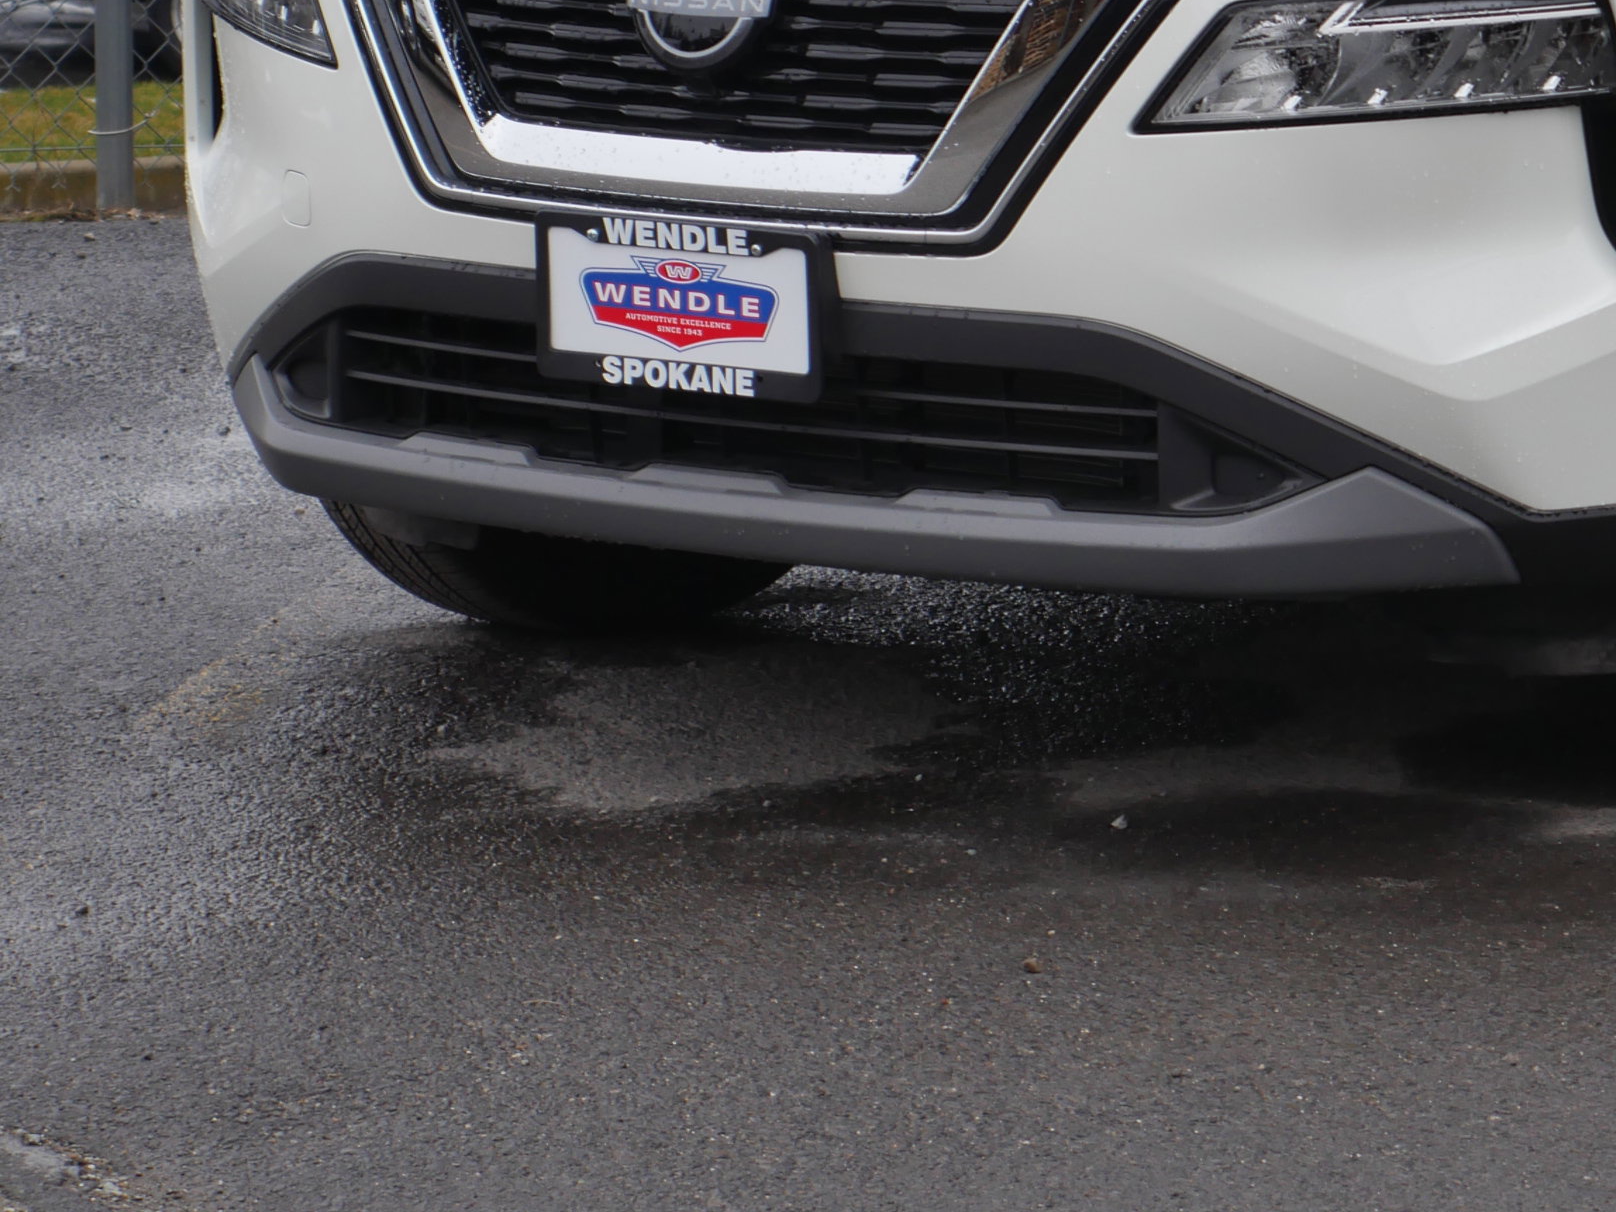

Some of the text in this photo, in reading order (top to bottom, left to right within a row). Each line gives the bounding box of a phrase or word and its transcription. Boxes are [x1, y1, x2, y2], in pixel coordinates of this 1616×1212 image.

[602, 217, 750, 256] WENDLE
[592, 280, 760, 319] WENDLE
[625, 312, 732, 330] AUTOMOTIVE EXCELLENCE
[656, 325, 682, 335] SINCE
[602, 355, 755, 397] SPOKANE
